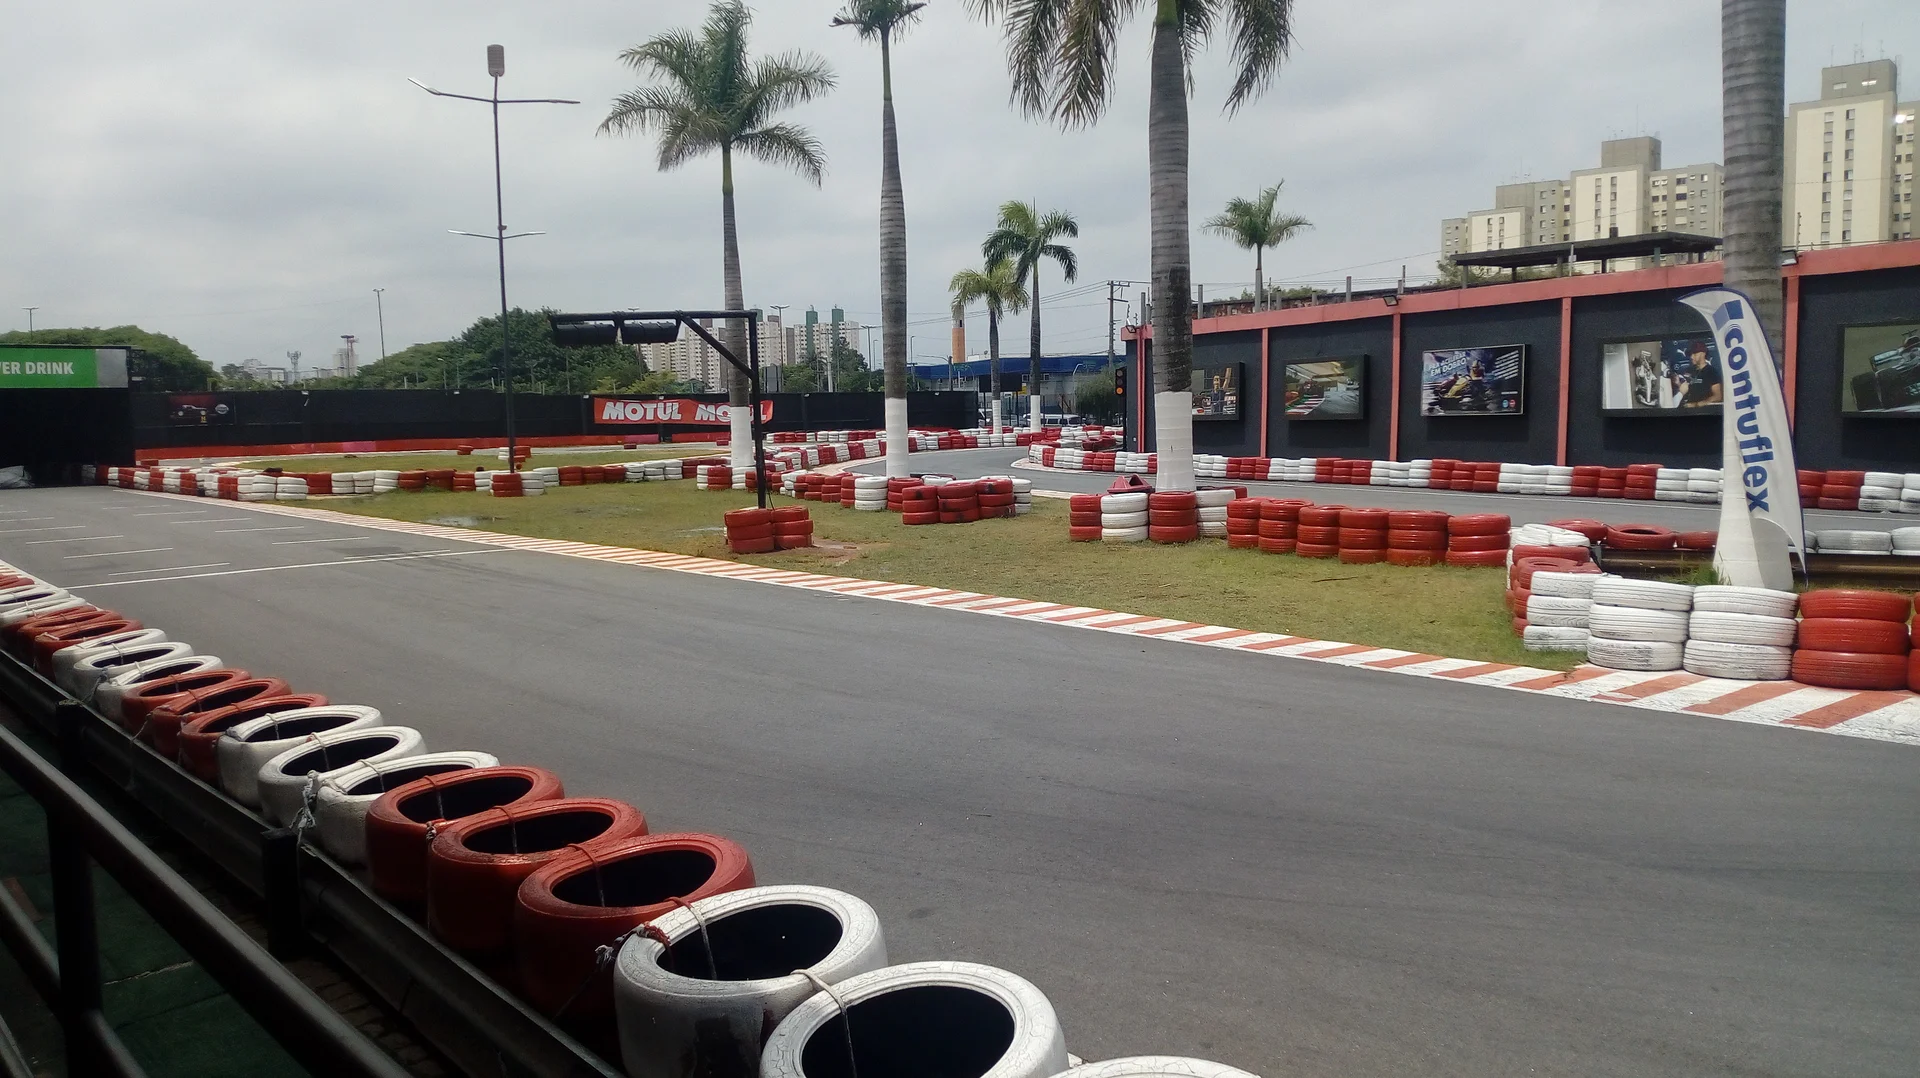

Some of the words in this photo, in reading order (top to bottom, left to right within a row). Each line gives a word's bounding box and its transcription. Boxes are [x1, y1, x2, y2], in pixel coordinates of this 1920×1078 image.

[25, 361, 75, 375] DRINK
[602, 401, 682, 421] MOTUL
[1724, 325, 1774, 513] contuflex
